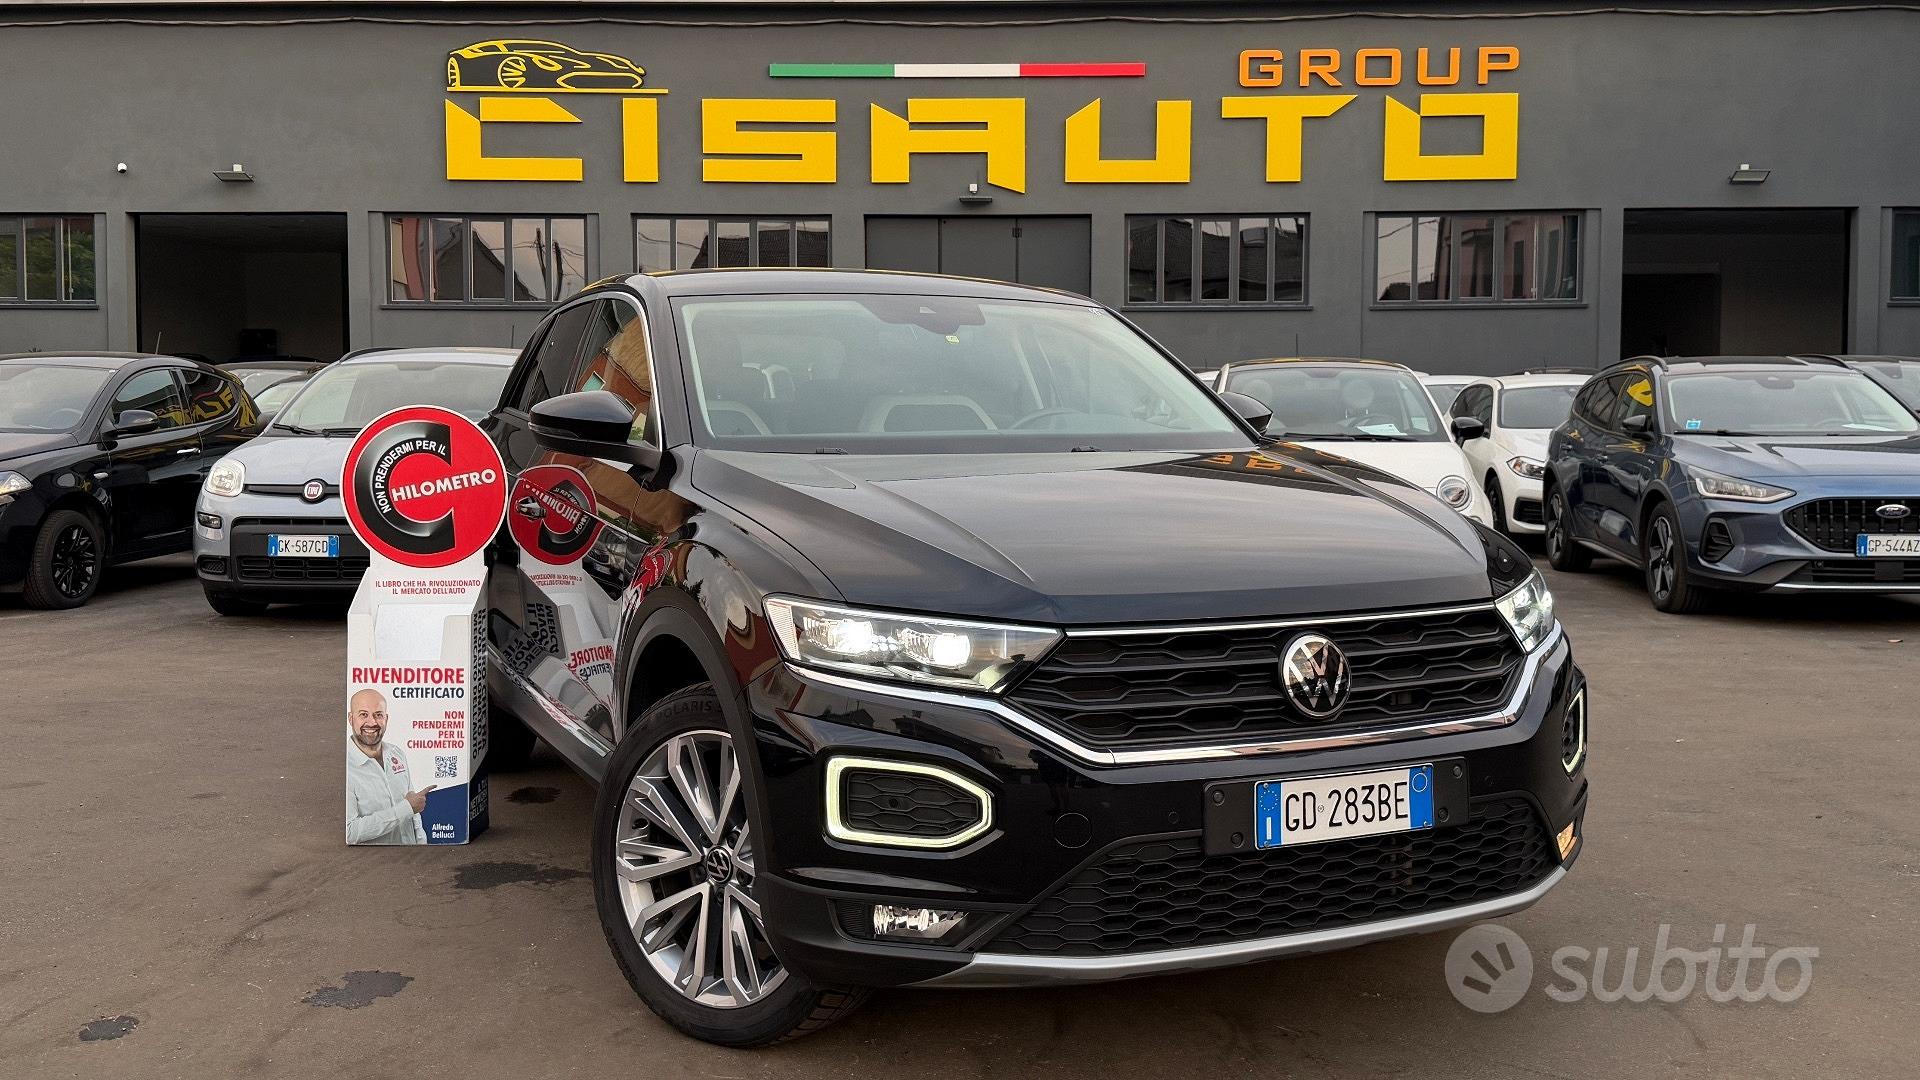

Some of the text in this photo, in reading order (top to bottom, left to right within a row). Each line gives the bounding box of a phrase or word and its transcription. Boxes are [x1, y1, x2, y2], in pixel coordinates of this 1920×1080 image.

[1239, 46, 1520, 87] GROUP
[445, 94, 1520, 194] CISAUTO
[374, 440, 447, 514] NON PRENDERMI PER IL
[375, 580, 381, 588] IL
[382, 580, 402, 588] LIBRO
[402, 580, 416, 588] CHE
[428, 579, 481, 587] RIVOLUZIONATO
[400, 587, 432, 595] MERCATO
[432, 587, 466, 595] DELL'AUTO
[352, 667, 465, 684] RIVENDITORE
[392, 687, 465, 699] CERTIFICATO
[444, 710, 465, 720] NON
[412, 720, 465, 729] PRENDERMI
[438, 730, 465, 739] PER IL
[406, 739, 465, 749] CHILOMETRO
[431, 823, 454, 831] Alfredo
[431, 831, 455, 839] Bellucci
